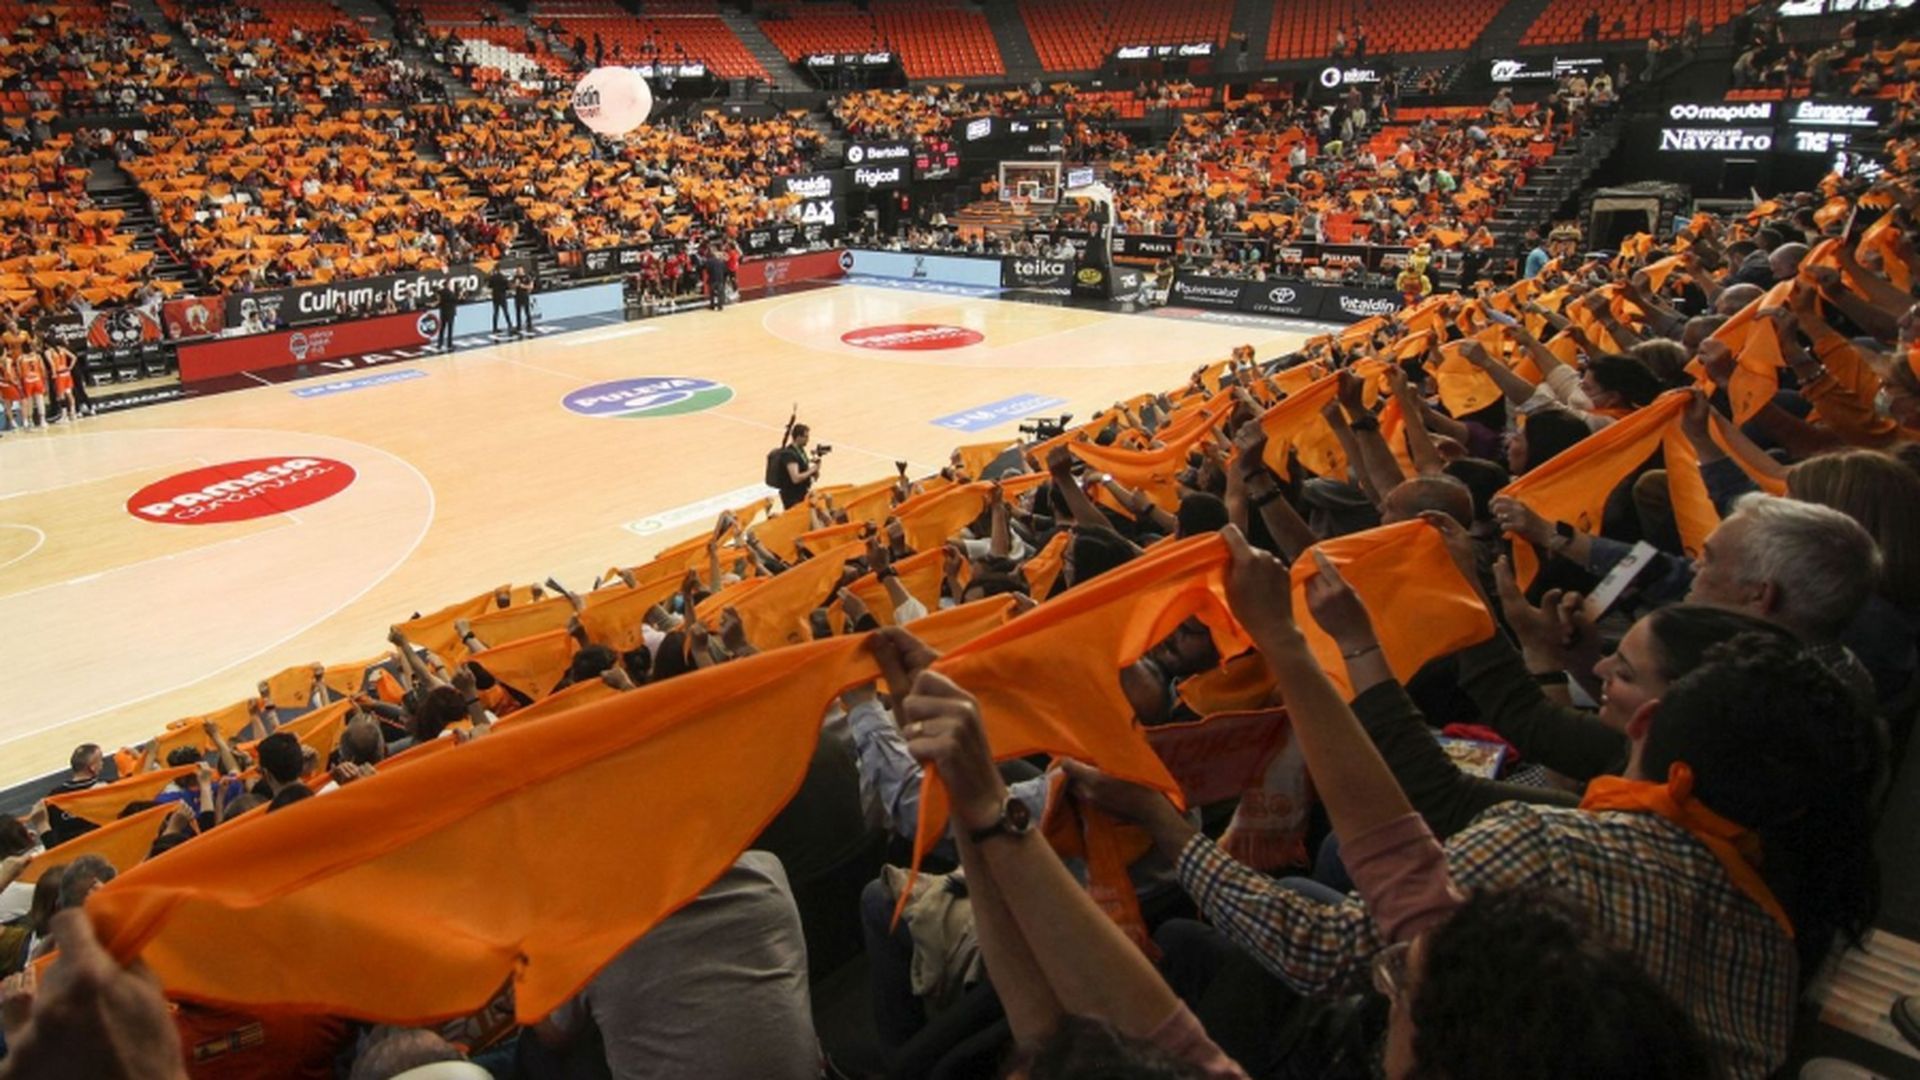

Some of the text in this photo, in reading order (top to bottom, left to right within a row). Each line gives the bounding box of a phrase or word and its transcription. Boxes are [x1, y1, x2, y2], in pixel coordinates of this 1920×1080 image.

[1699, 102, 1771, 121] mapubli
[1797, 101, 1872, 119] Europcar
[1659, 128, 1771, 150] Navarro
[1013, 259, 1065, 276] teika
[573, 377, 698, 408] PULEVA
[138, 456, 321, 517] PAMESA
